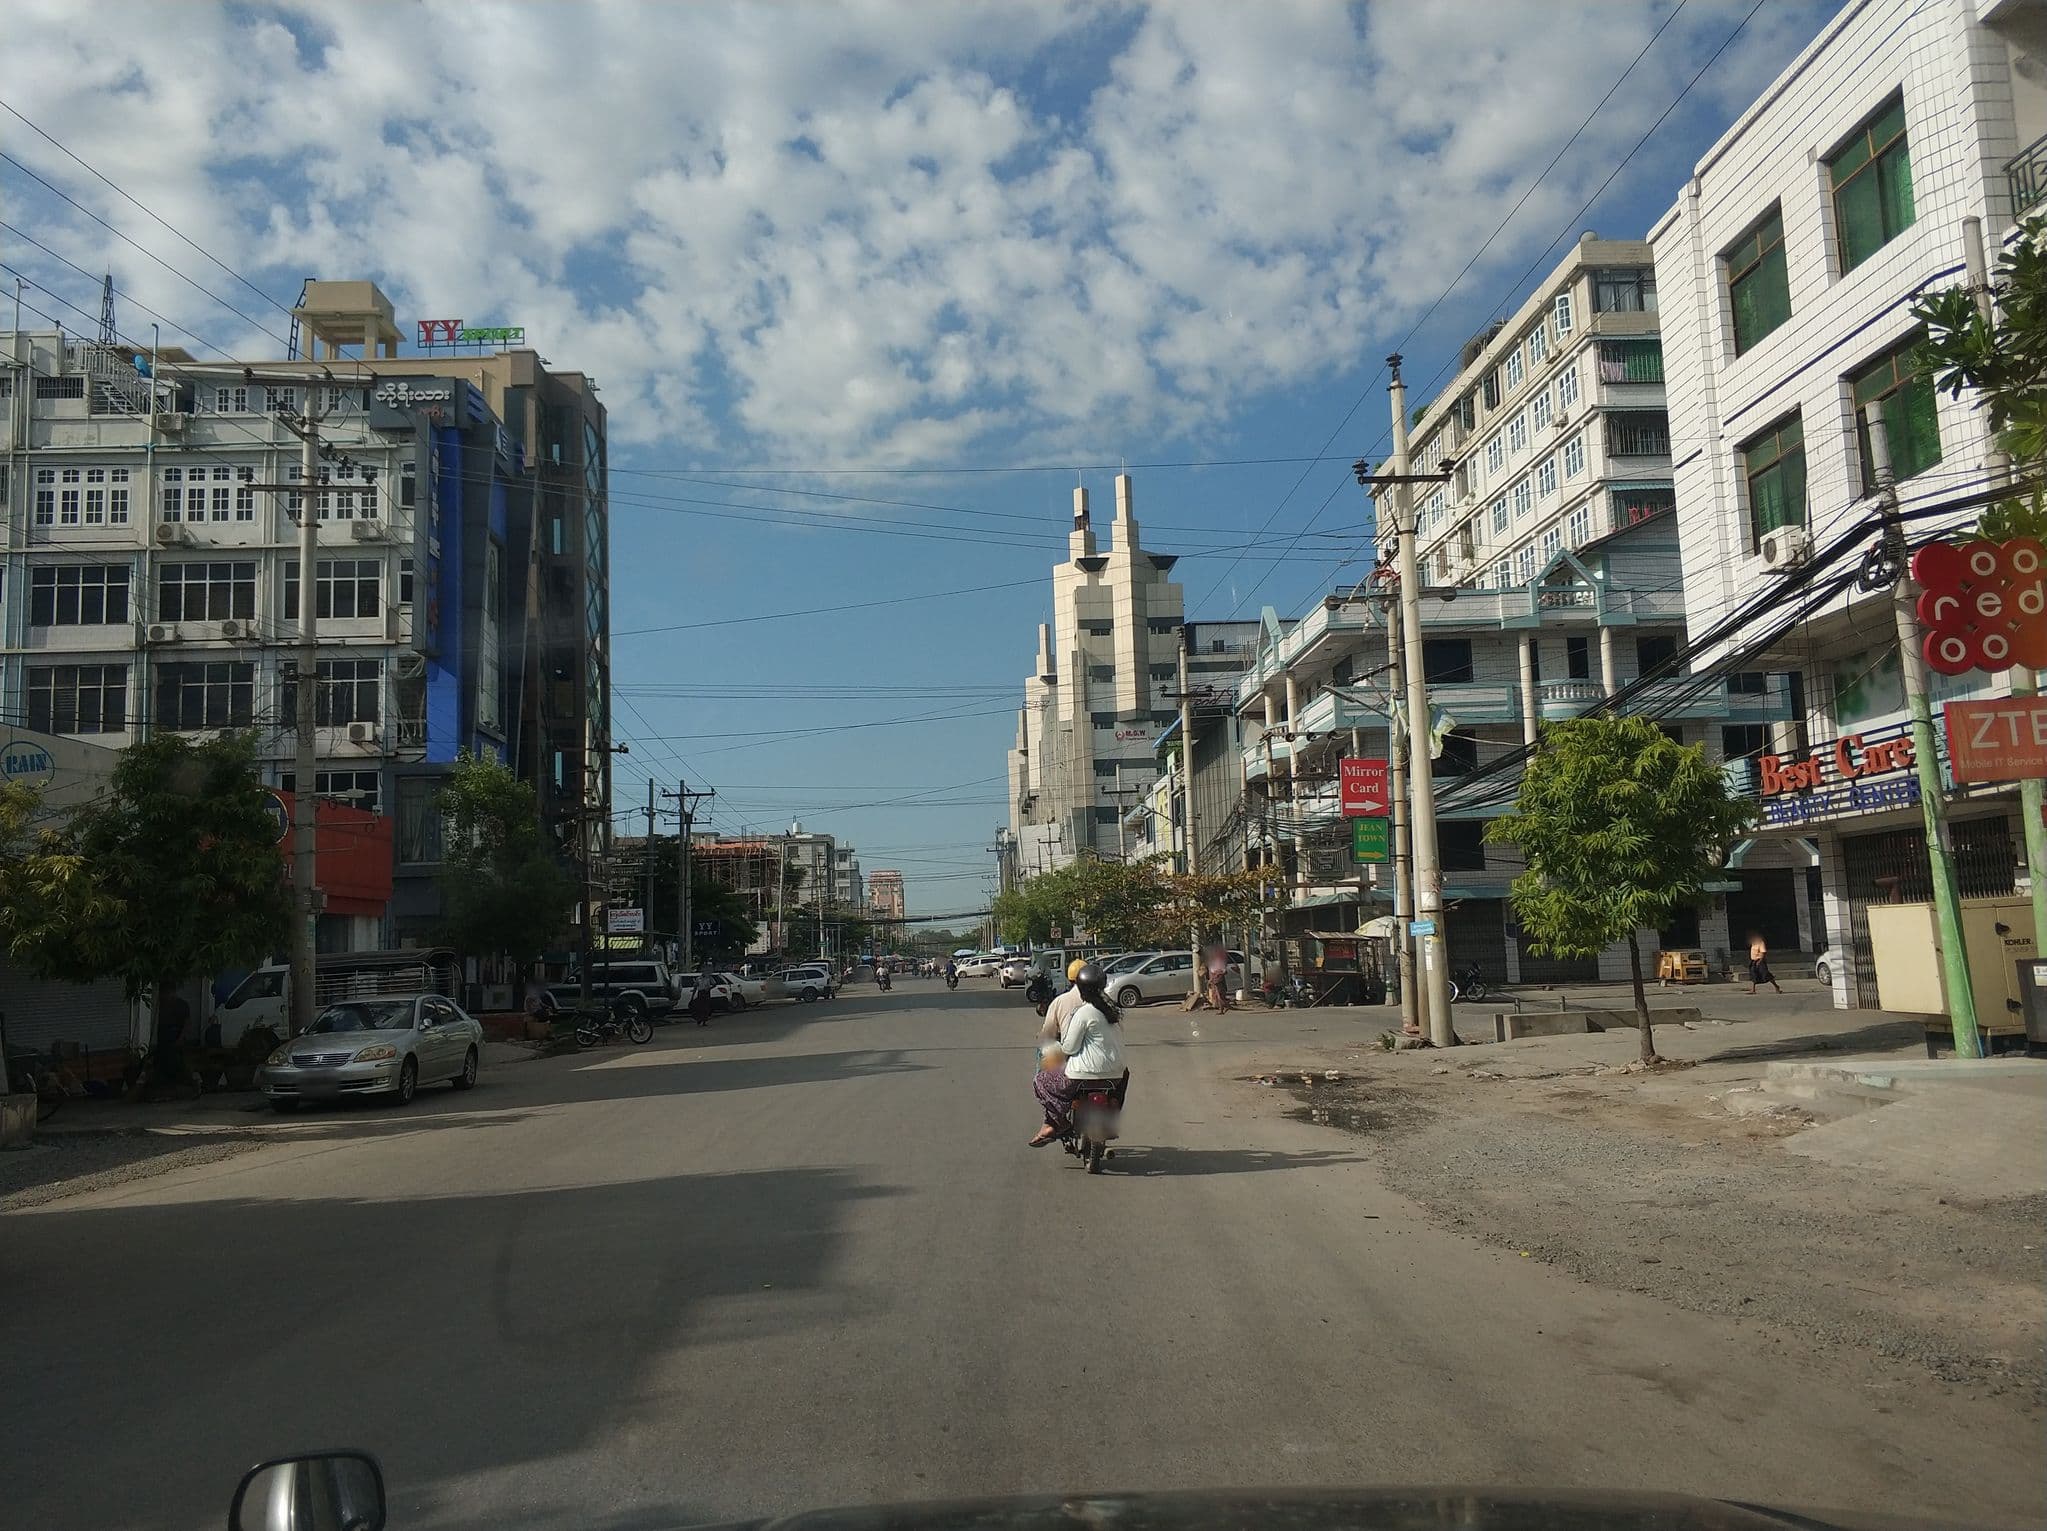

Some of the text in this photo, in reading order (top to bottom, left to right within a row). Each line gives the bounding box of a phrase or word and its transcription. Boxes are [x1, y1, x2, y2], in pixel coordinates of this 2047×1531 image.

[419, 320, 461, 343] YY
[1968, 709, 2047, 749] ZTE
[6, 753, 48, 774] RAIN
[1344, 766, 1385, 777] Mirror
[1758, 754, 1825, 796] Best
[1835, 734, 1917, 778] Care
[1350, 782, 1379, 793] Card
[1769, 774, 1922, 824] BEAUTY CENTER
[1359, 823, 1383, 831] JEAN
[1358, 834, 1386, 842] TOWN
